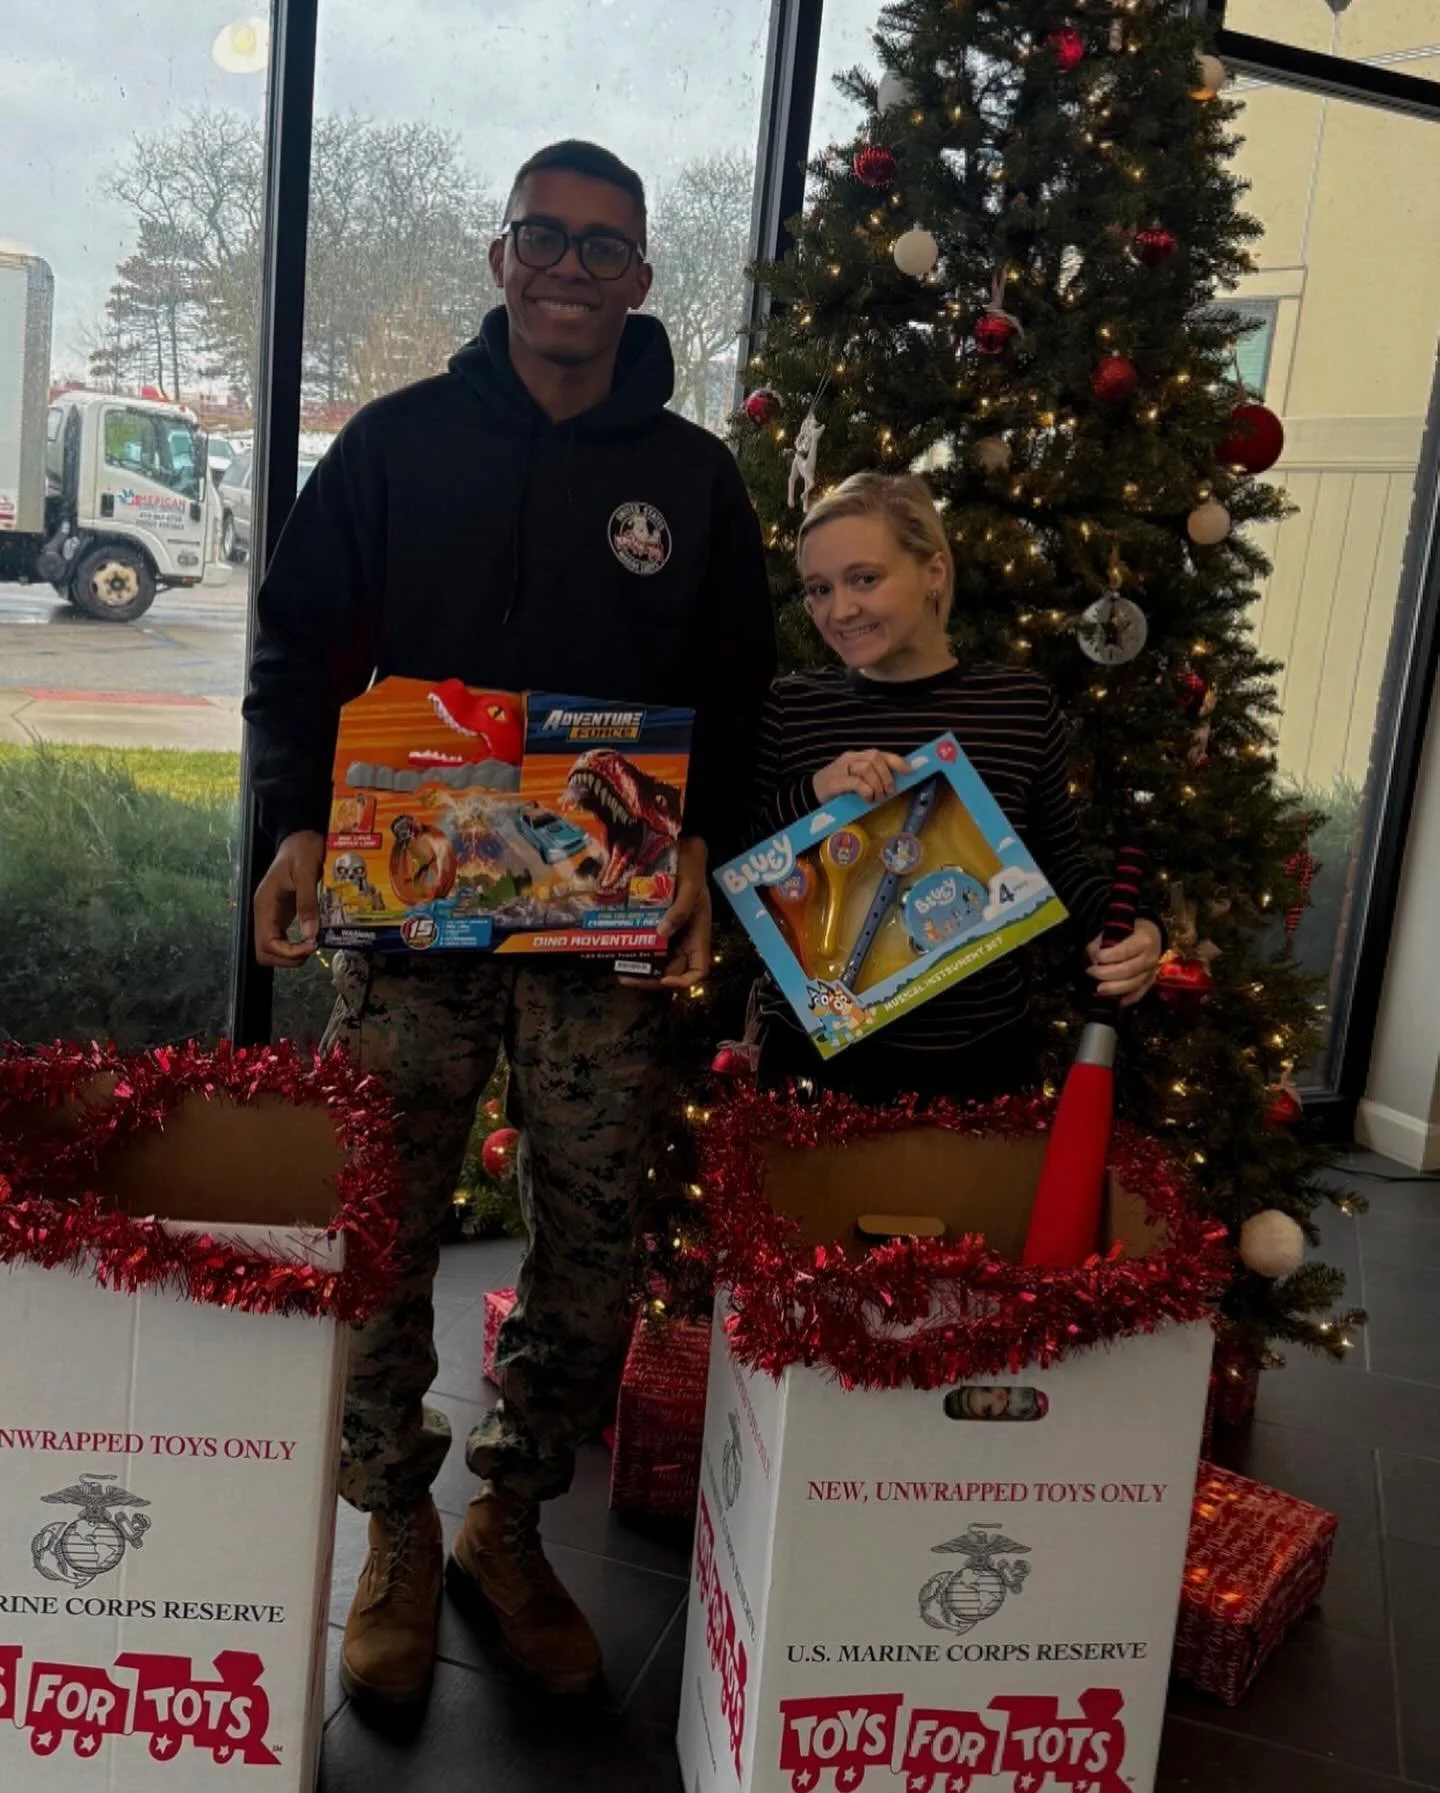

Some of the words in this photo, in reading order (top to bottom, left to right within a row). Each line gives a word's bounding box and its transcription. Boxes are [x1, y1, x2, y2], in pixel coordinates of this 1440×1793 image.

[543, 709, 643, 731] ADVENTURE
[999, 882, 1015, 904] 4
[409, 919, 434, 938] 15
[532, 936, 568, 948] DINO
[569, 934, 657, 947] ADVENTURE
[883, 984, 926, 1012] MUSICAL
[984, 934, 1004, 951] SET
[0, 1428, 143, 1454] NWRAPPED
[152, 1434, 217, 1457] TOYS
[223, 1439, 297, 1460] ONLY
[807, 1481, 869, 1504] NEW,
[875, 1481, 1028, 1502] UNWRAPPED
[1033, 1482, 1096, 1502] TOYS
[1100, 1482, 1169, 1503] ONLY
[0, 1594, 58, 1615] RINE
[66, 1597, 156, 1618] CORPS
[162, 1601, 286, 1623] RESERVE
[786, 1644, 832, 1663] U.S.
[837, 1644, 941, 1663] MARINE
[946, 1643, 1030, 1662] CORPS
[1036, 1641, 1148, 1661] RESERVE
[32, 1673, 116, 1726] FOR
[143, 1686, 253, 1740] TOTS
[791, 1707, 887, 1759] TOYS
[908, 1719, 986, 1768] FOR
[1011, 1726, 1113, 1774] TOTS
